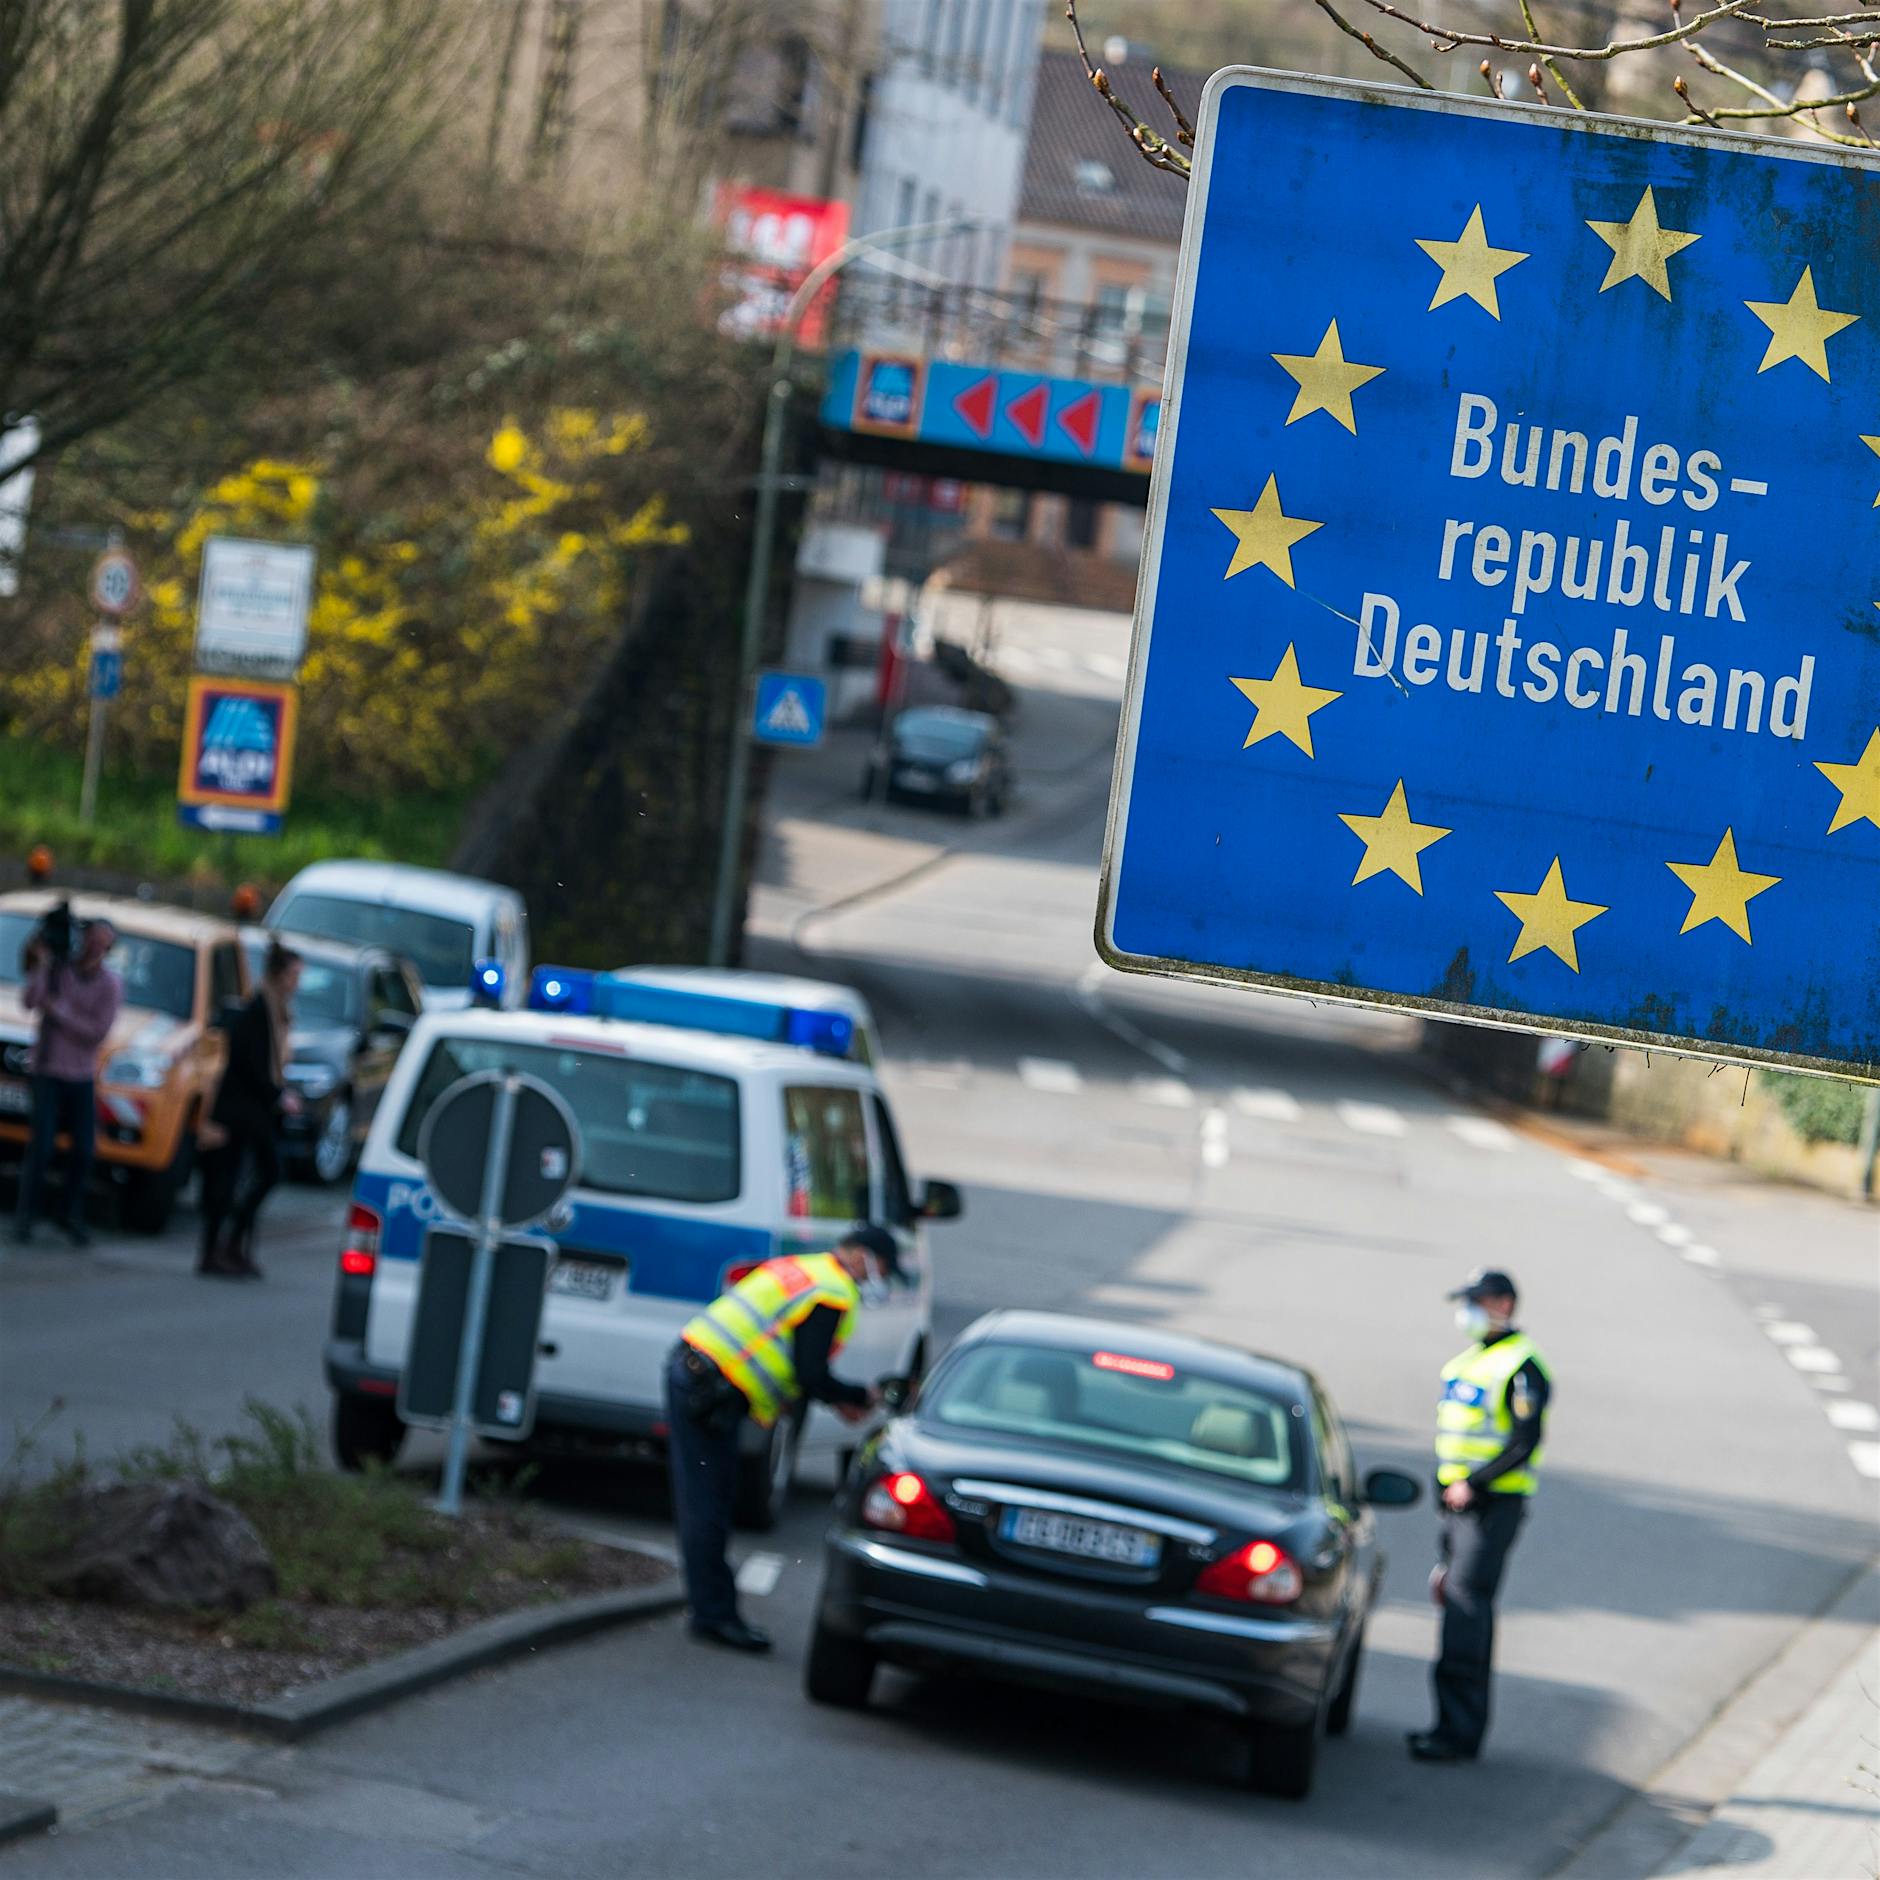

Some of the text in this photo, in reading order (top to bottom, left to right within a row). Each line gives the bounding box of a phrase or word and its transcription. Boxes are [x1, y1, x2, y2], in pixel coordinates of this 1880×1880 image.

[1449, 392, 1769, 512] Bundes-
[1437, 518, 1752, 623] republik
[1352, 591, 1816, 740] Deutschland
